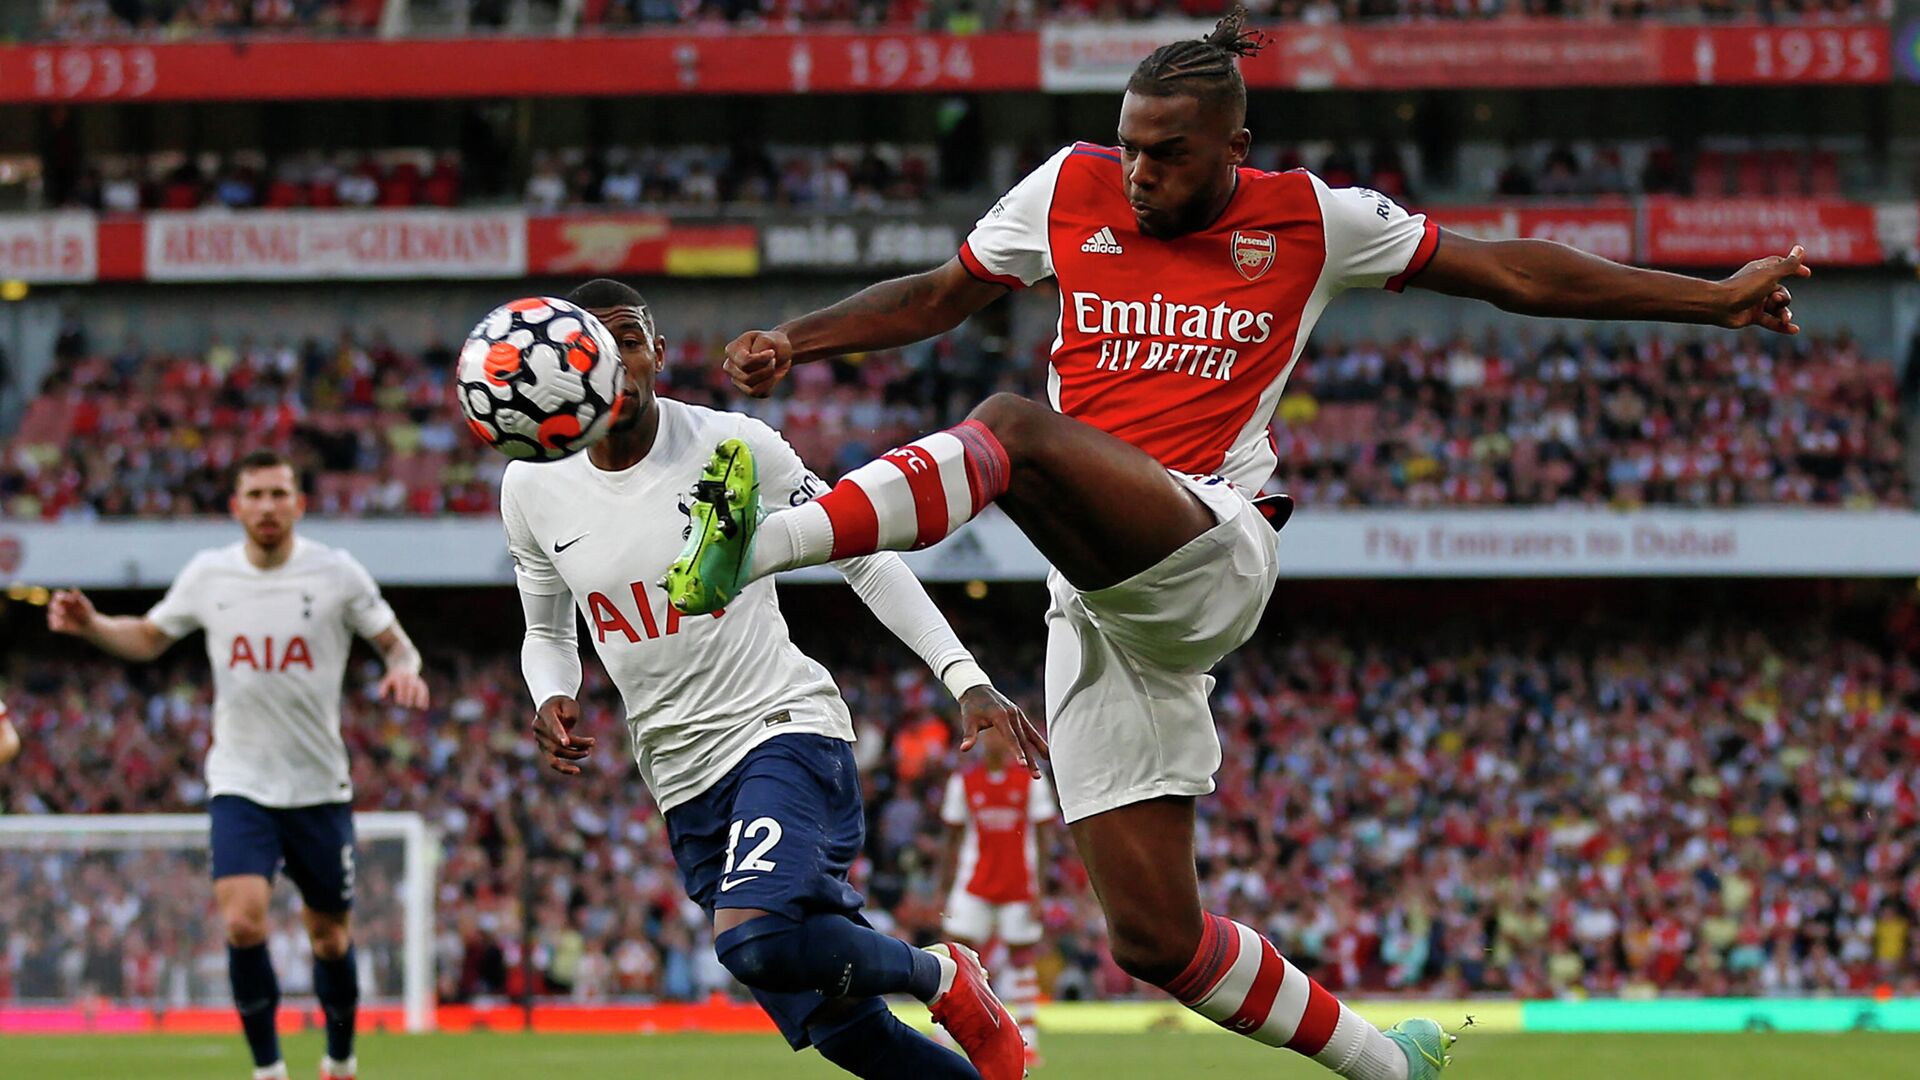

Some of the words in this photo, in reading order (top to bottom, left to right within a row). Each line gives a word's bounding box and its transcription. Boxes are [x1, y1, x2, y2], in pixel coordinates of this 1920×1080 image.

[33, 49, 156, 97] 1933
[849, 38, 974, 86] 1934
[1754, 30, 1877, 79] 1935
[1081, 242, 1123, 254] adidas
[1238, 235, 1271, 247] Arsenal
[1072, 291, 1274, 344] Emirates
[1096, 339, 1142, 372] FLY
[1141, 341, 1238, 381] BETTER
[1364, 526, 1419, 568] Fly
[1428, 526, 1577, 559] Emirates
[1585, 527, 1622, 557] to
[1631, 525, 1737, 559] Dubai
[228, 634, 315, 672] AIA
[723, 816, 783, 874] 12
